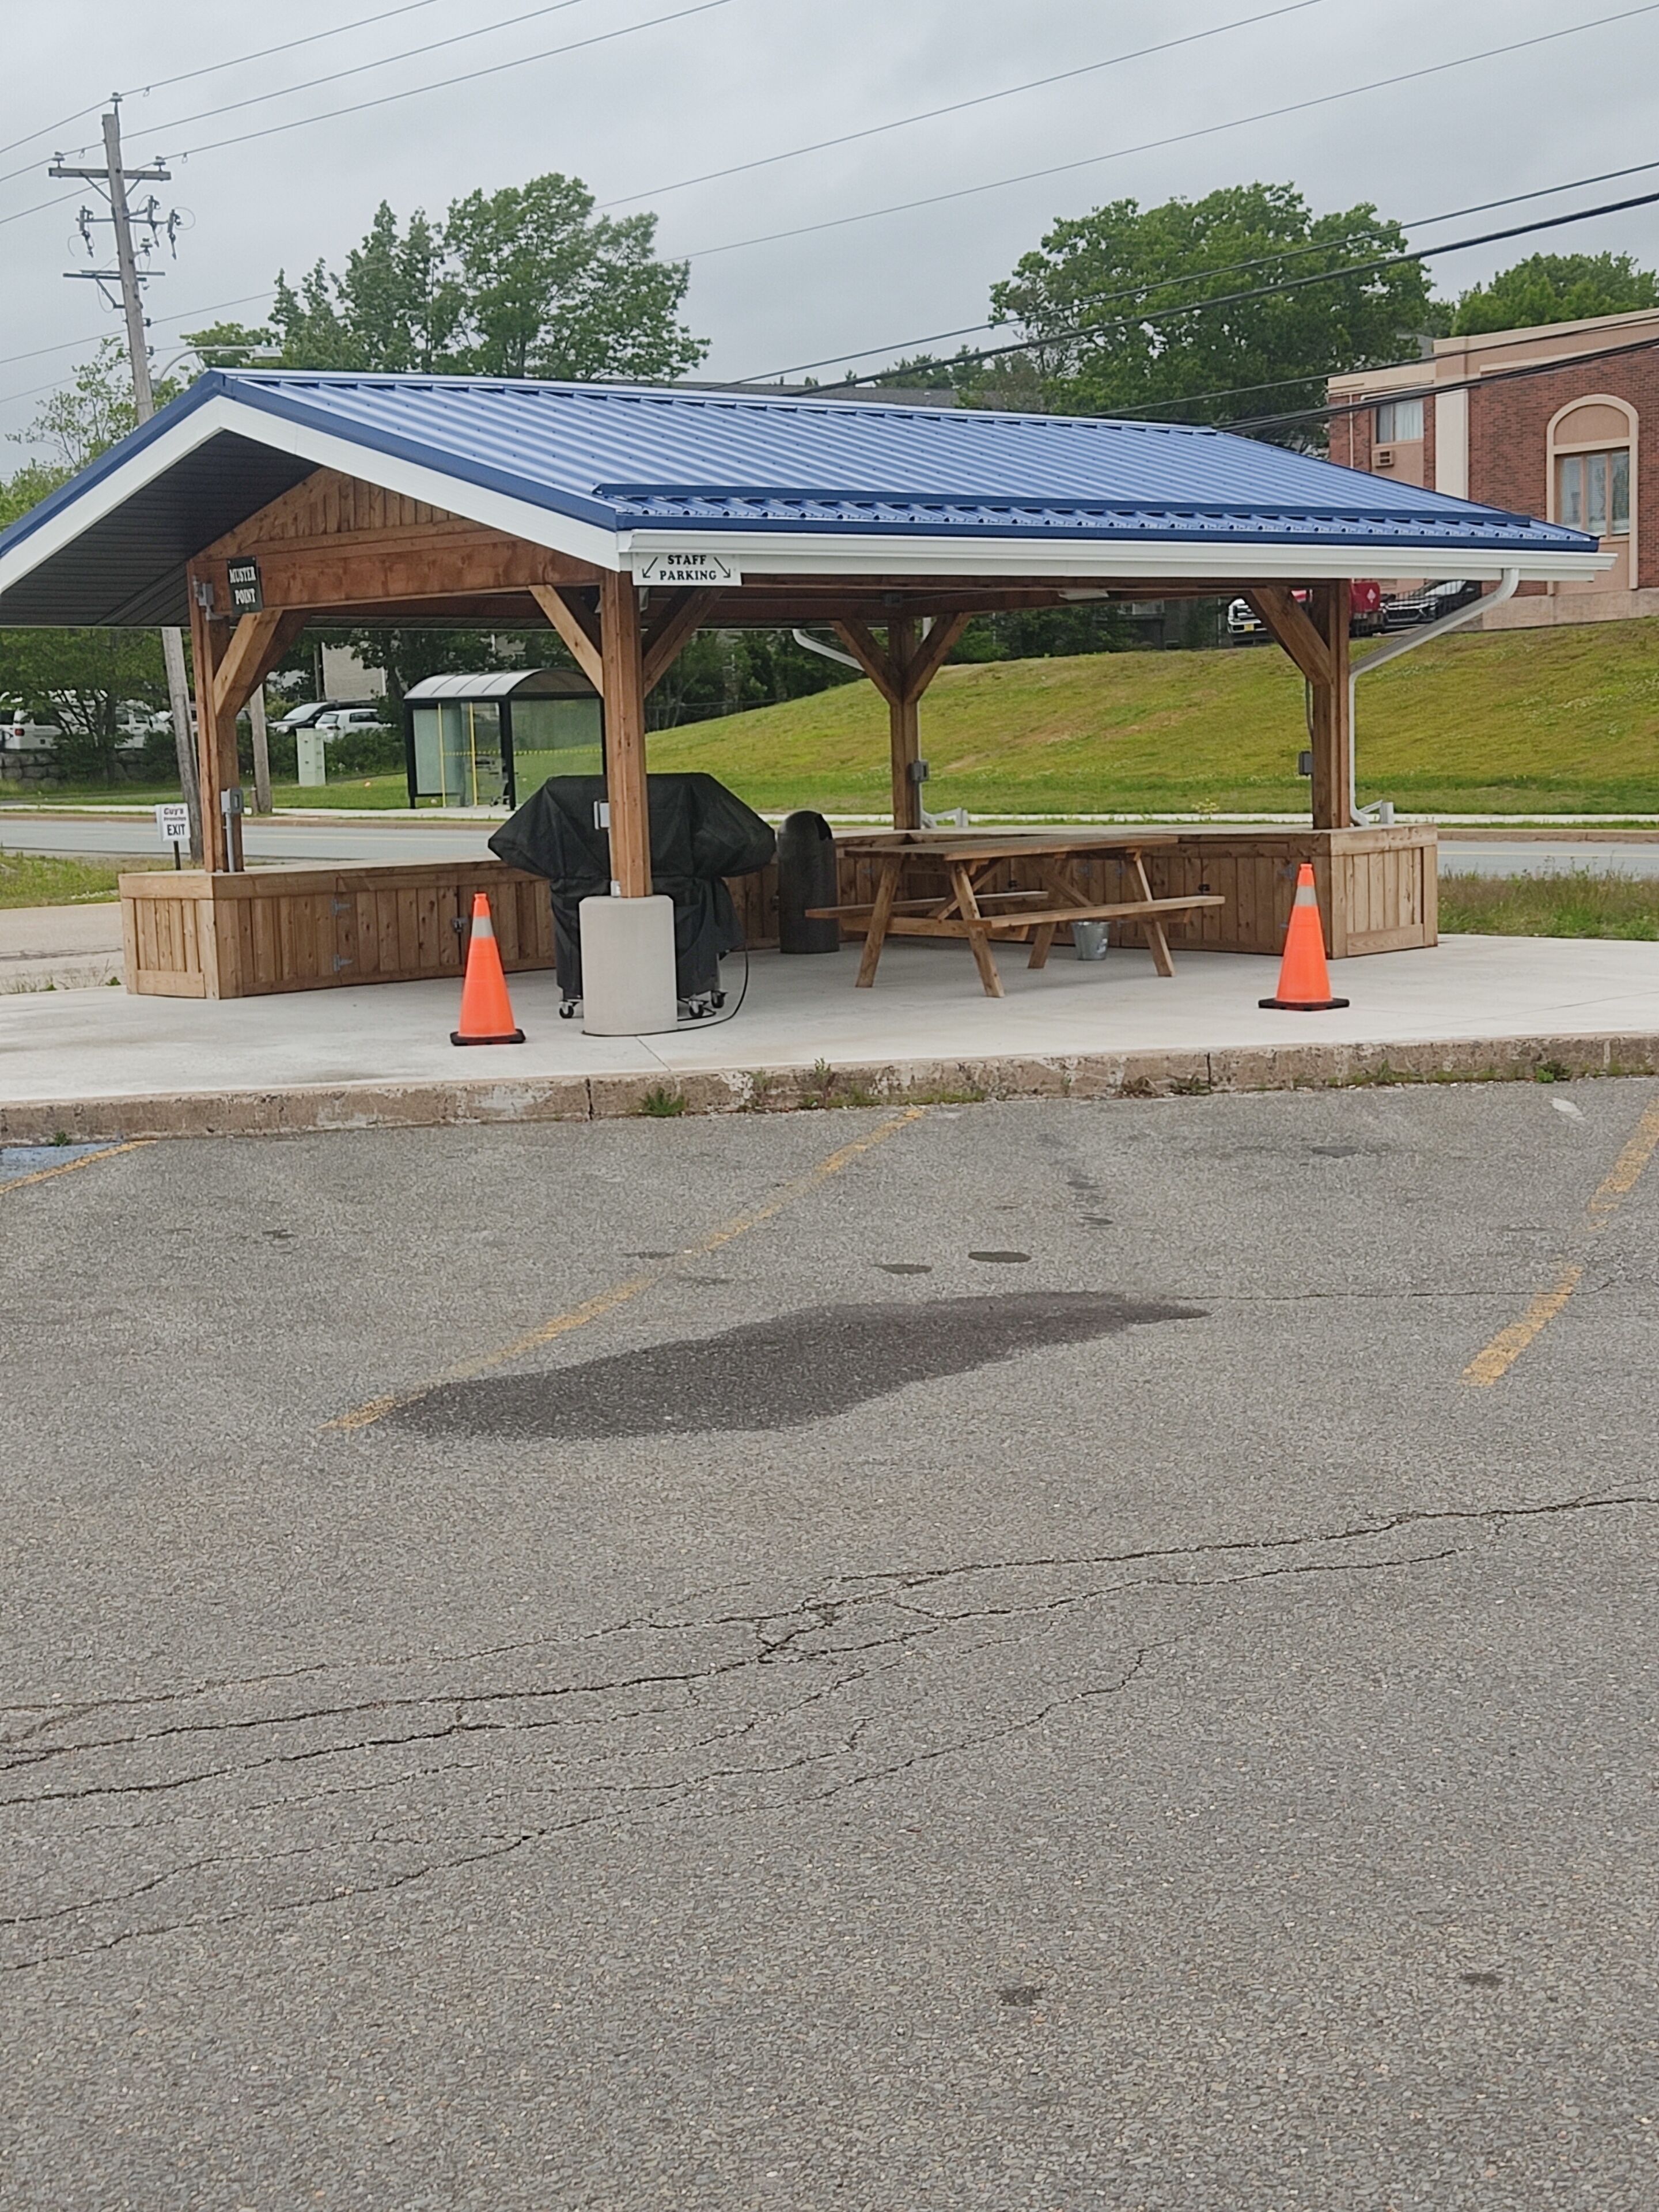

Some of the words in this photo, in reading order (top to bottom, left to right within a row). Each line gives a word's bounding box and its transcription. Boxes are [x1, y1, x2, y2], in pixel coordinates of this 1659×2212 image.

[668, 555, 706, 565] STAFF
[229, 566, 256, 583] MUSTER
[660, 570, 717, 580] PARKING
[234, 588, 256, 605] POINT
[167, 824, 185, 835] EXIT
